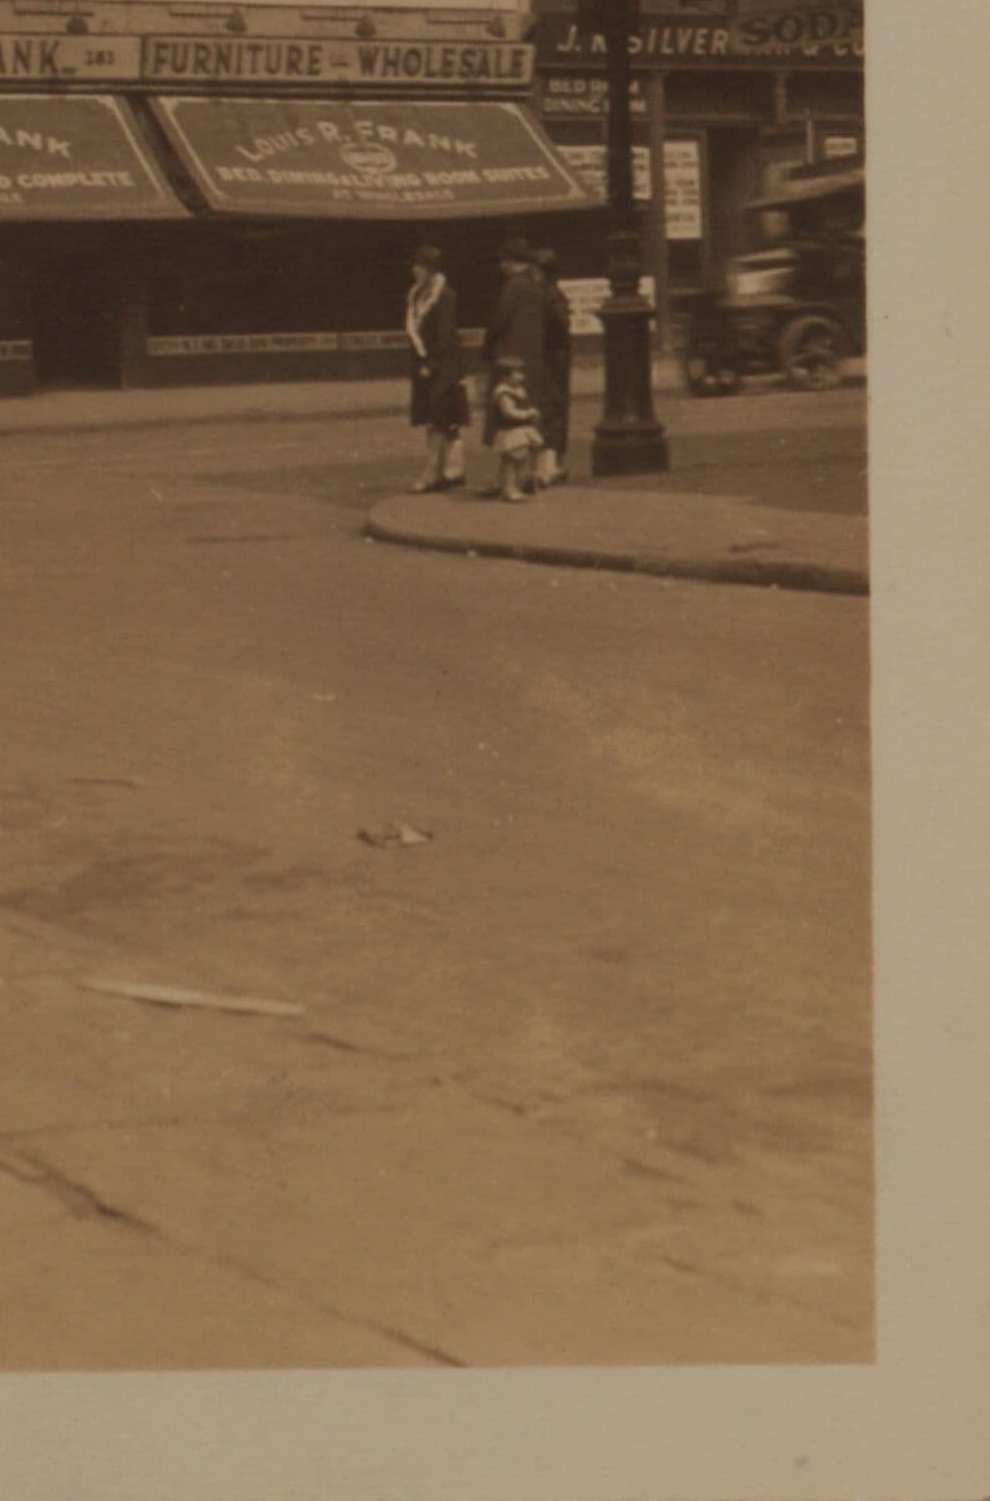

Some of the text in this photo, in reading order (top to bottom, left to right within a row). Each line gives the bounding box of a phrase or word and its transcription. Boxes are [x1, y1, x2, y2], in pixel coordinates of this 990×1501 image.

[150, 41, 324, 77] FURNITURE
[357, 46, 525, 81] WHOLESALE
[236, 127, 314, 164] LOUIS
[315, 120, 351, 142] R.
[356, 120, 479, 159] FRANK
[16, 170, 136, 189] COMPLETE
